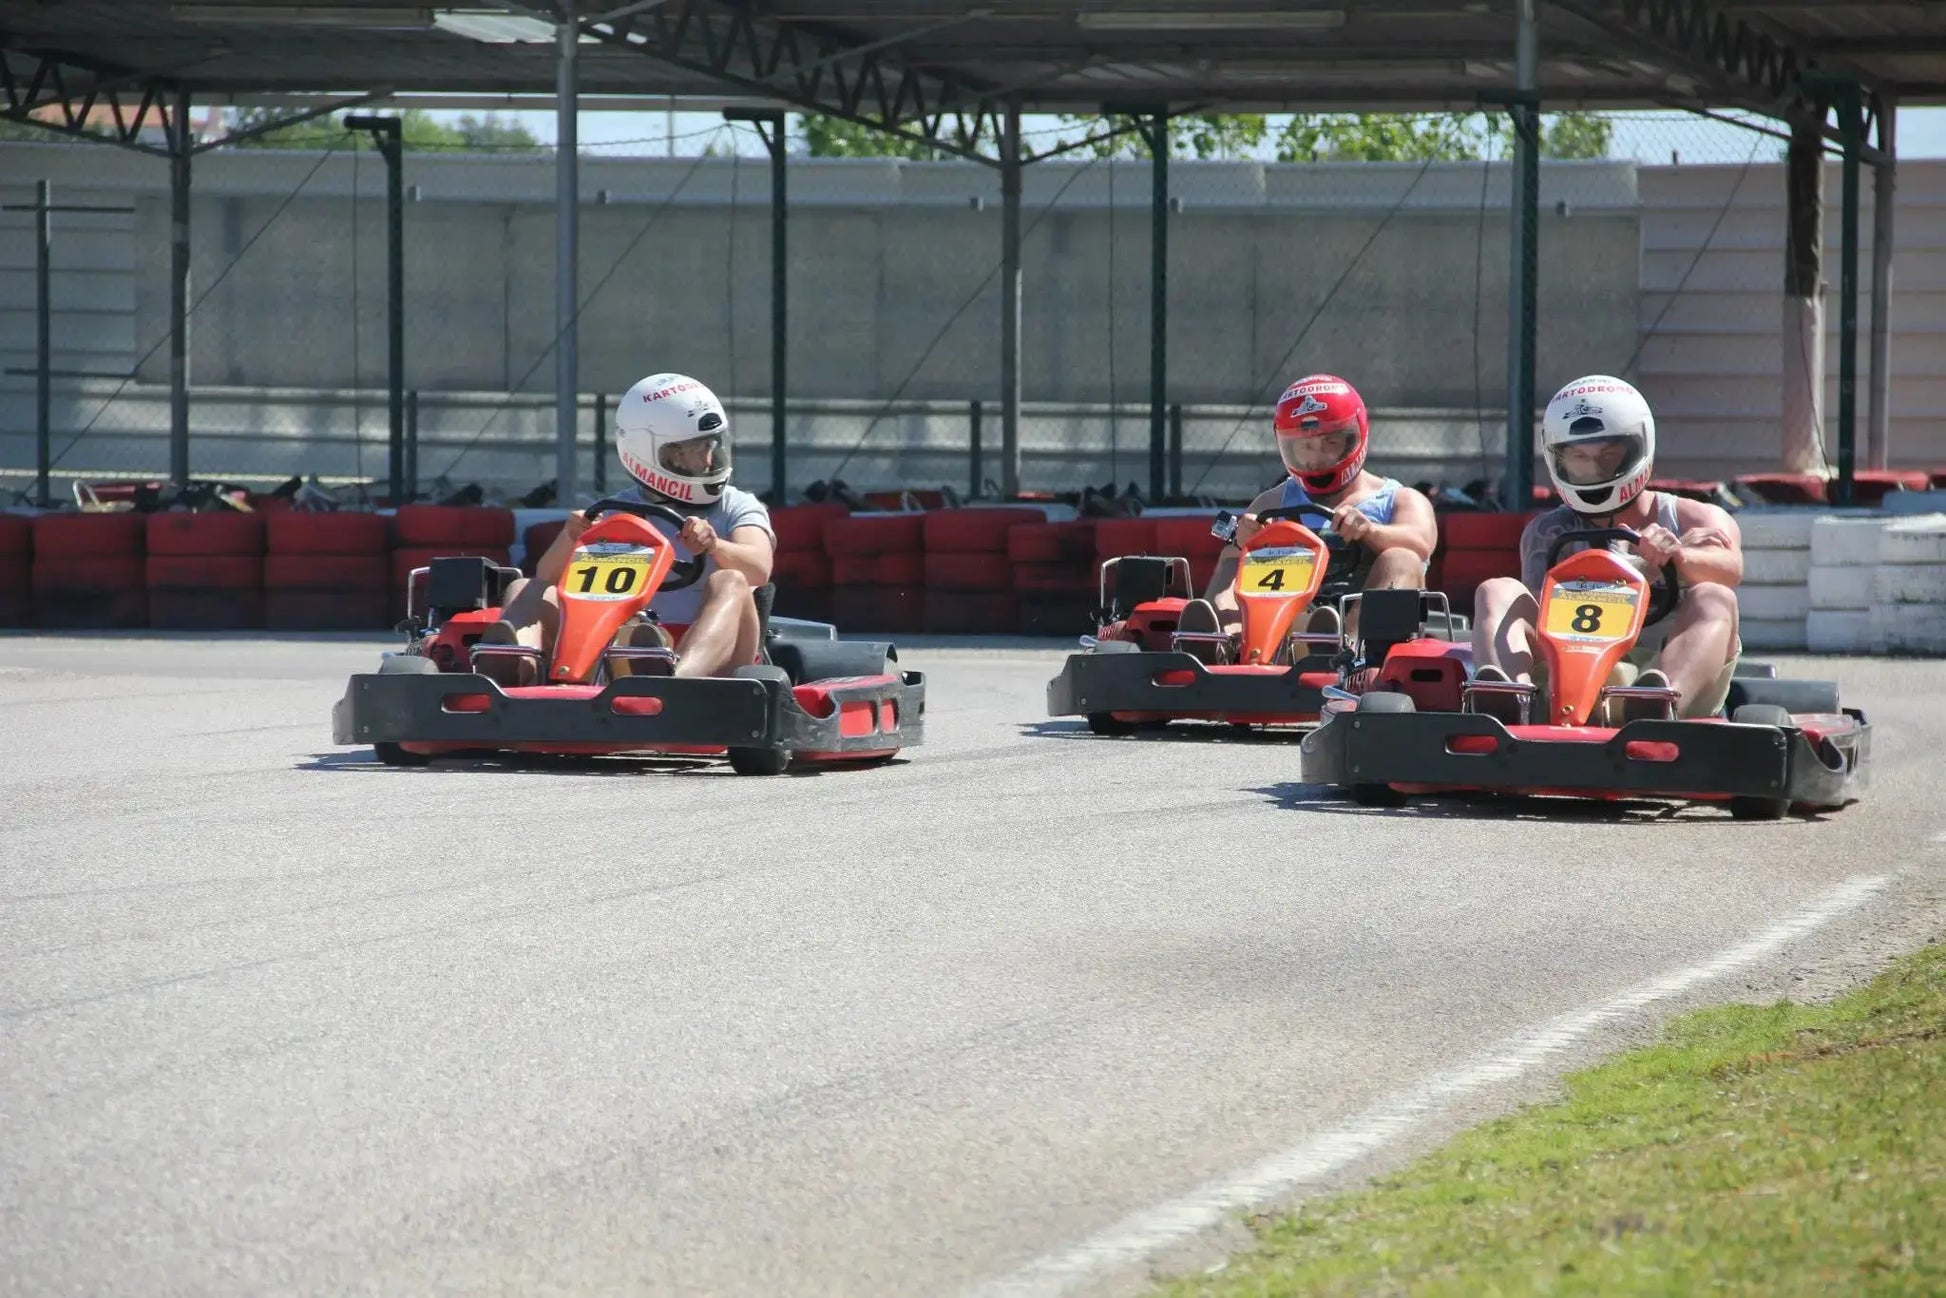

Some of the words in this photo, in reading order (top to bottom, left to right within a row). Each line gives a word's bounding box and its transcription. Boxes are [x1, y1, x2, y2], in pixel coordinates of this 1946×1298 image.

[576, 565, 637, 594] 10
[1257, 569, 1286, 592] 4
[1571, 604, 1604, 633] 8
